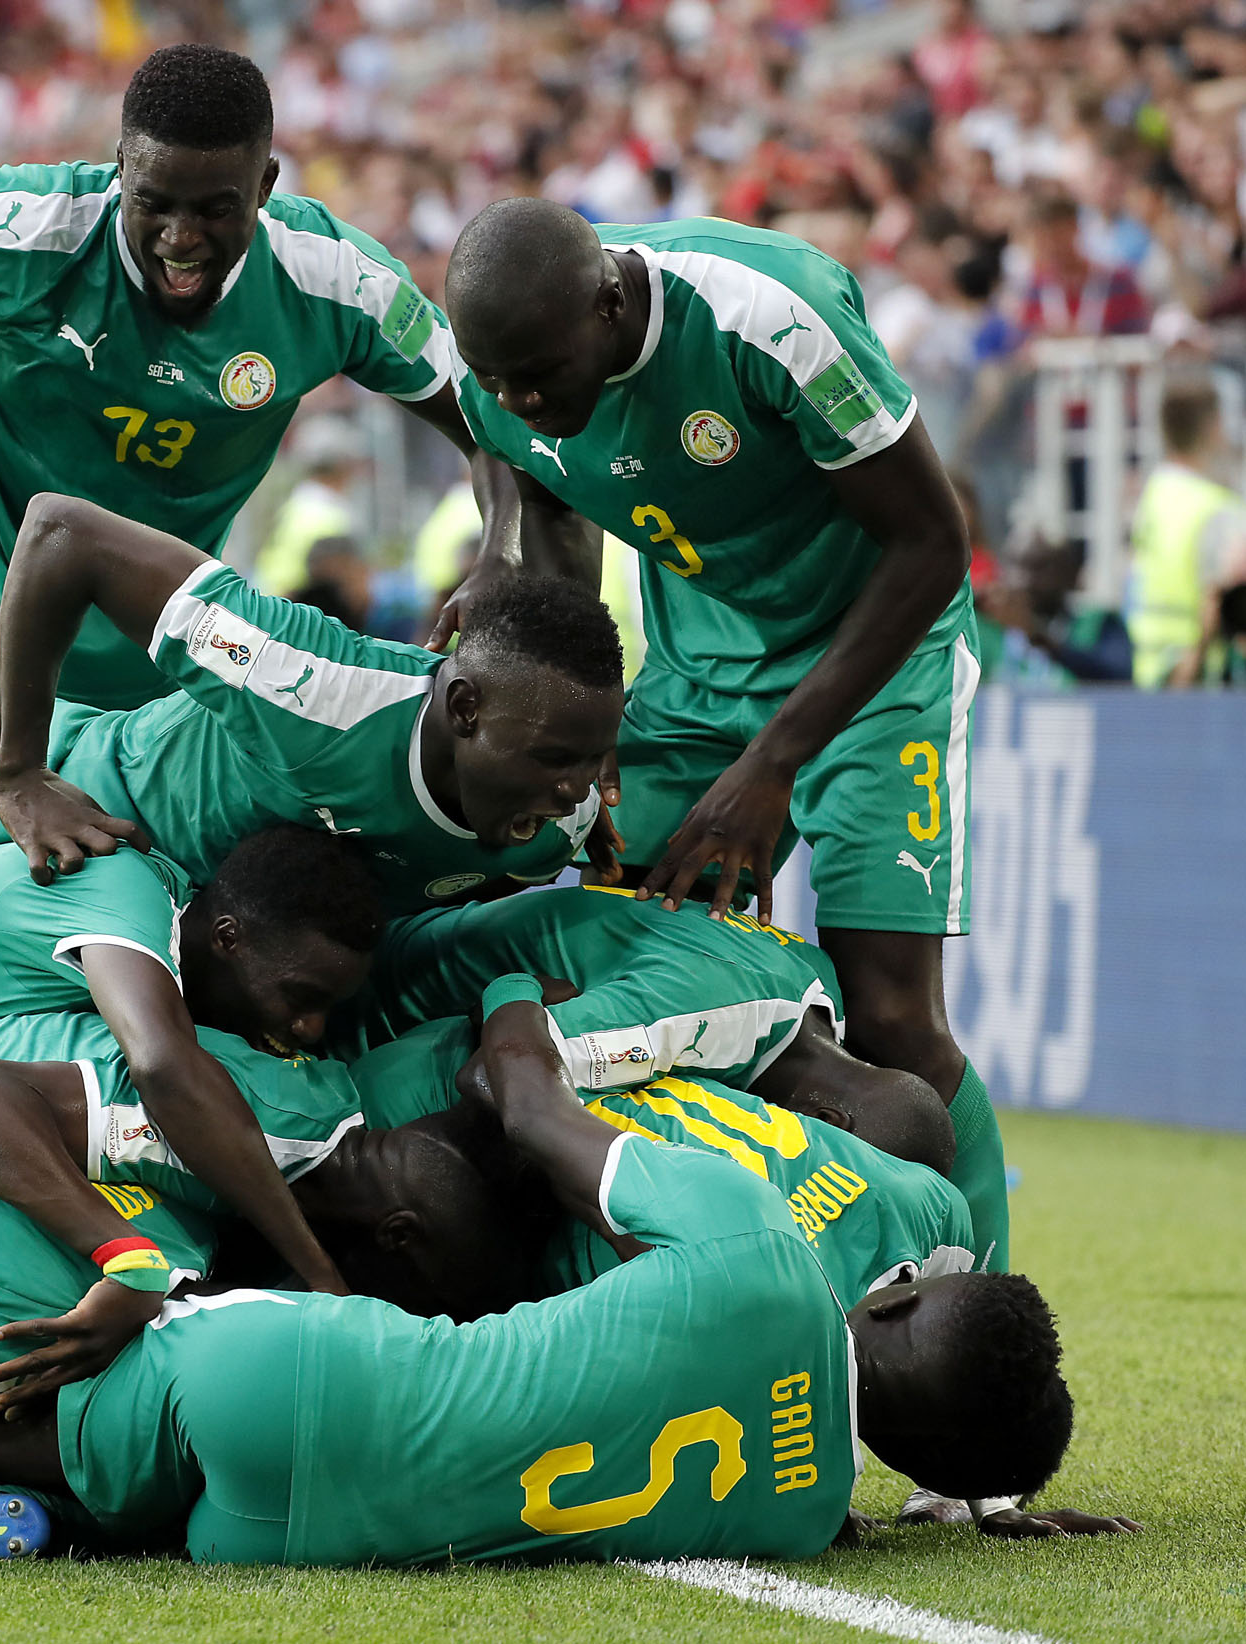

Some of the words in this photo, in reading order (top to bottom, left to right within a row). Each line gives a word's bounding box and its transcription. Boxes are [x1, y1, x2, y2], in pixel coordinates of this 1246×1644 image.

[147, 364, 164, 378] SEN
[170, 367, 185, 382] POL
[817, 370, 857, 406] LIVING
[856, 388, 871, 403] FIFA
[103, 406, 197, 469] 13
[610, 462, 625, 475] SEN
[629, 459, 645, 472] POL
[631, 504, 704, 578] 3
[197, 607, 220, 638] RUSSIA
[191, 638, 202, 656] 2018
[900, 741, 941, 842] 3
[588, 1036, 603, 1065] RUSSIA
[771, 1371, 818, 1494] GANA
[520, 1406, 747, 1535] 5
